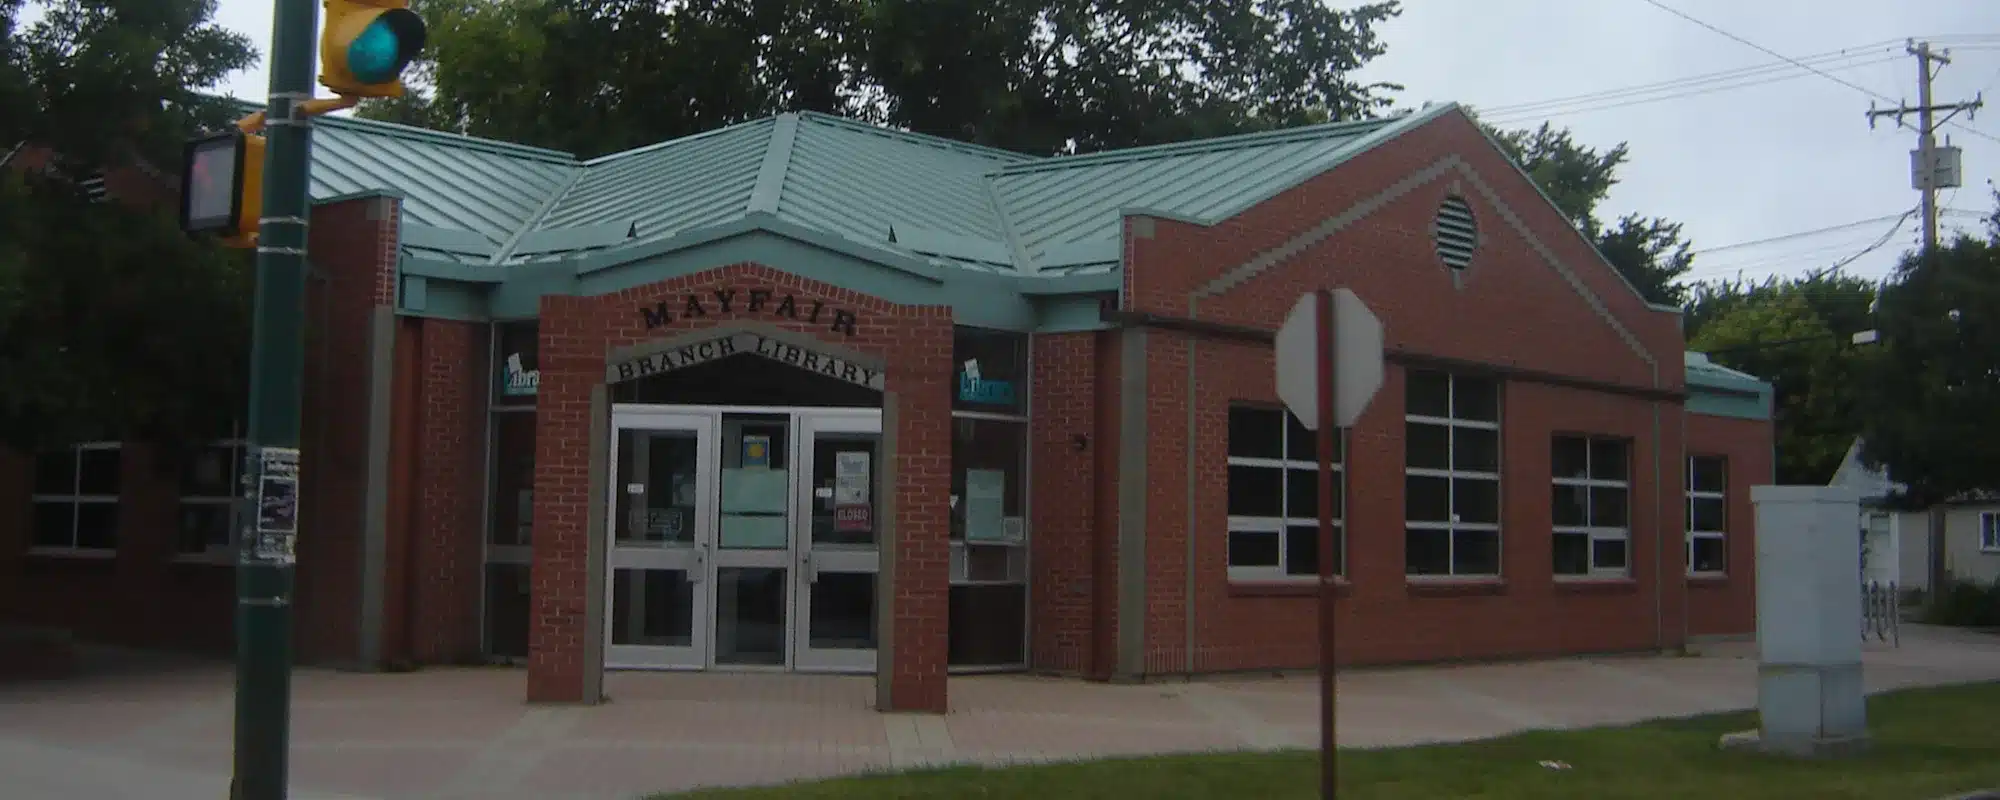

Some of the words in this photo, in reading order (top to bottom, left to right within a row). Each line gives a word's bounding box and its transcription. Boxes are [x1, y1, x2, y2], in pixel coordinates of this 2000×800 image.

[640, 289, 857, 336] MAYFAIR
[618, 337, 735, 380] BRANCH
[757, 336, 877, 385] LIBRARY
